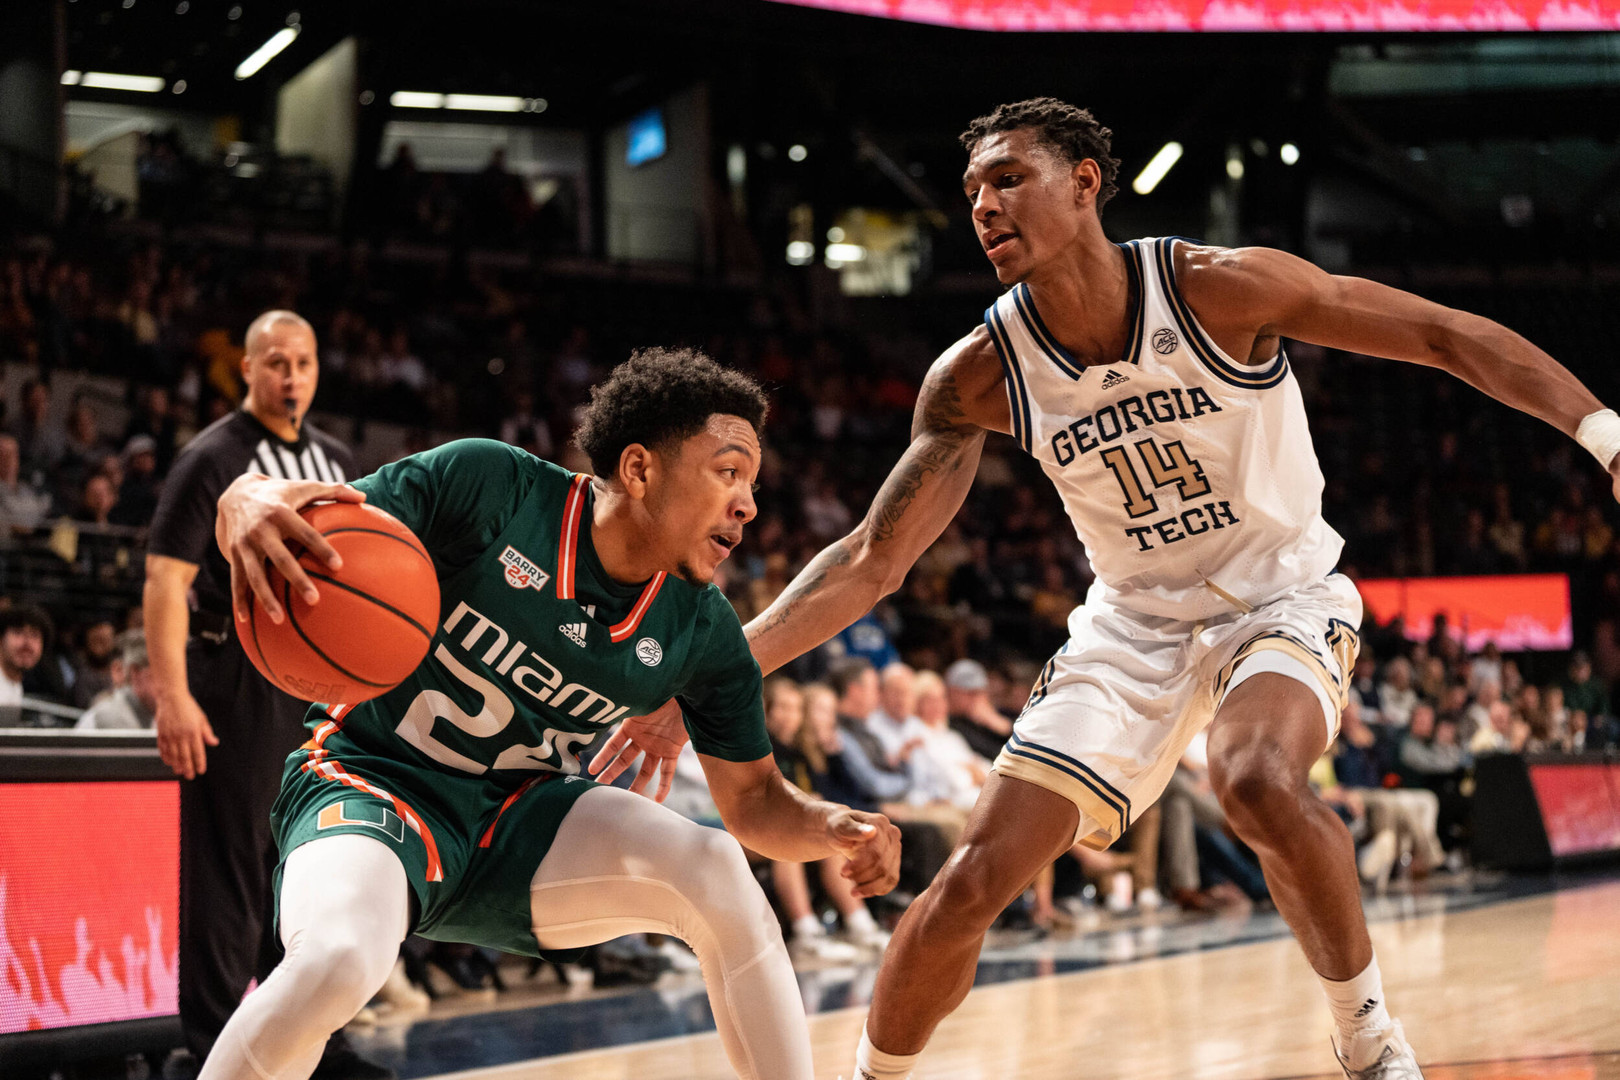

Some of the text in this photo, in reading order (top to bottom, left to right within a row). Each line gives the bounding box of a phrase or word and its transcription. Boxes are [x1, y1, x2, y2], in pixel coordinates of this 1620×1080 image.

[1101, 375, 1131, 390] adidas
[1051, 386, 1223, 467] GEORGIA
[1099, 437, 1212, 519] 14
[1124, 501, 1240, 552] TECH
[505, 550, 545, 581] BARRY
[507, 565, 530, 585] 24
[558, 624, 587, 648] adidas
